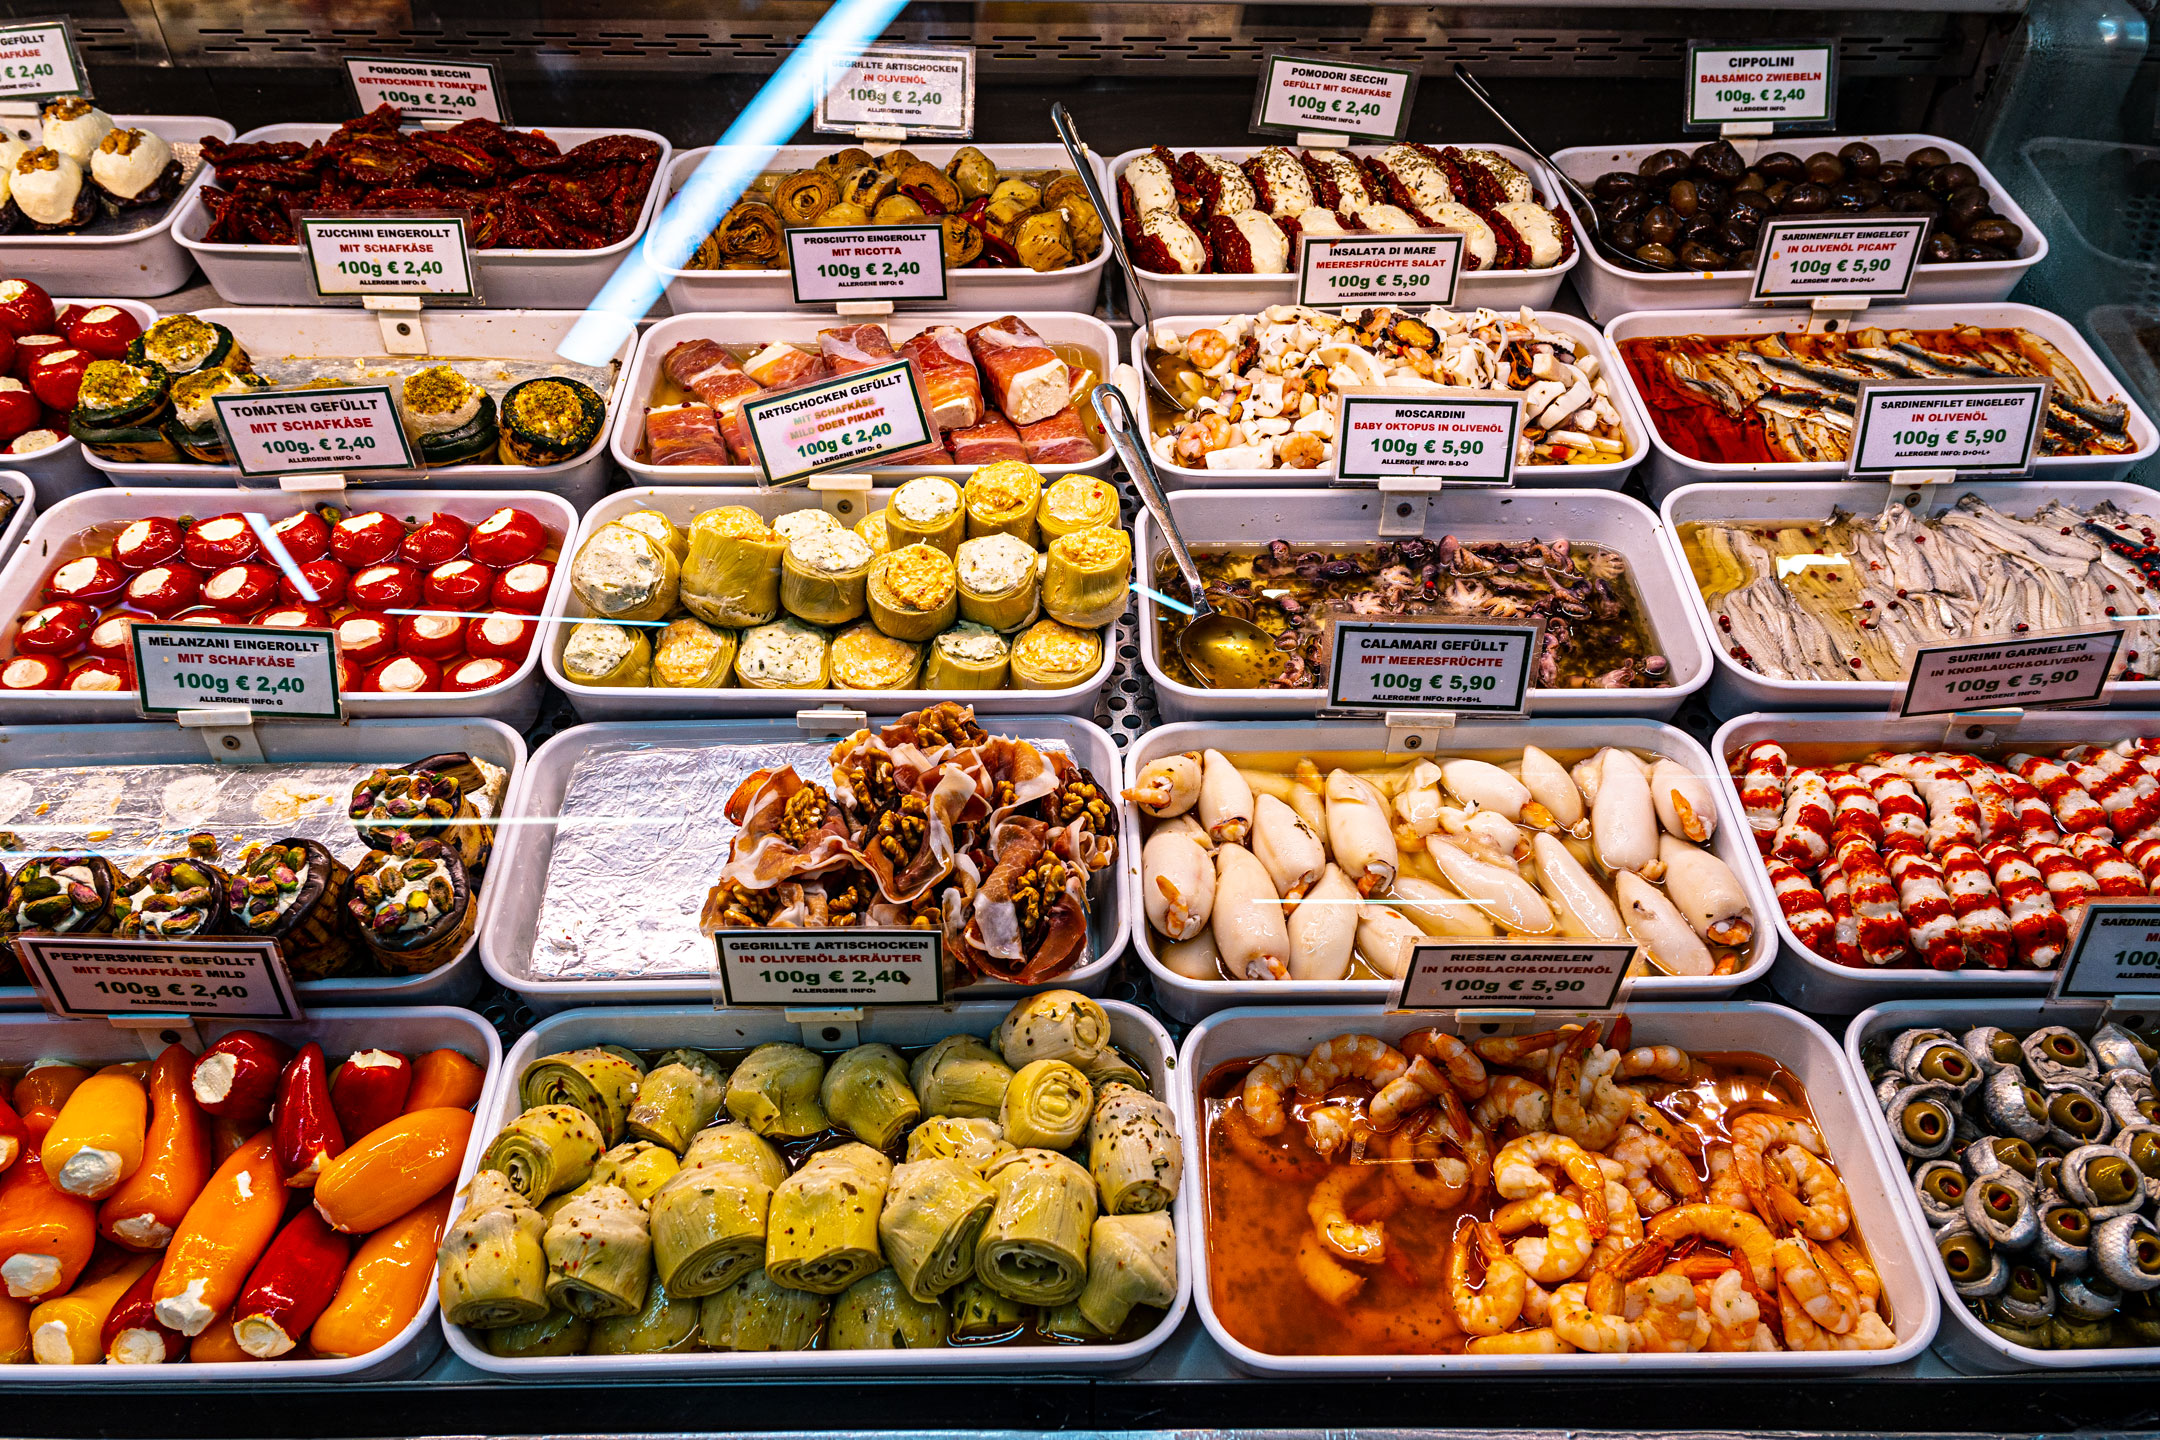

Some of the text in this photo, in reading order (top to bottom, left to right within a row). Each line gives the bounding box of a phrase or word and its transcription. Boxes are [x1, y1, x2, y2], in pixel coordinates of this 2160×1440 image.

[1, 35, 44, 45] GEFÜLLT
[886, 63, 958, 73] ARTISCHOCKEN
[1729, 57, 1794, 67] CIPPOLINI
[5, 64, 53, 79] € 2,40
[369, 66, 471, 79] POMODORI SECCHI
[1292, 68, 1387, 85] POMODORI SECCHI
[1701, 72, 1821, 83] BALSAMICO ZWIEBELN
[359, 77, 487, 91] GETROCKNETE TOMATEN
[877, 74, 926, 84] OLIVENÖL
[1283, 80, 1320, 90] GEFÜLLT
[1341, 87, 1391, 98] SCHAFKÄSE
[378, 91, 476, 107] 100g € 2,40
[848, 89, 942, 106] 100g € 2,40
[1716, 89, 1805, 104] 100g. € 2,40
[1288, 95, 1380, 116] 100g € 2,40
[317, 229, 373, 237] ZUCCHINI
[804, 234, 926, 244] PROSCIUTTO EINGEROLLT
[1782, 231, 1910, 241] SARDINENFILET EINGELEGT
[340, 243, 433, 252] MIT SCHAFKÄSE
[855, 247, 901, 255] RICOTTA
[1330, 248, 1385, 256] INSALATA
[1802, 243, 1853, 252] OLIVENÖL
[1857, 243, 1897, 251] PICANT
[338, 261, 443, 277] 100g € 2,40
[817, 262, 920, 279] 100g € 2,40
[1316, 259, 1408, 268] MEERESFRÜCHTE
[1790, 259, 1890, 275] 100g € 5,90
[1329, 275, 1430, 289] 100g € 5,90
[759, 375, 902, 420] ARTISCHOCKEN GEFÜLLT
[1881, 399, 2024, 409] SARDINENFILET EINGELEGT
[231, 399, 377, 417] TOMATEN GEFÜLLT
[794, 397, 875, 425] MIT SCHAFKÄSE
[1395, 410, 1465, 418] MOSCARDINI
[1912, 411, 1987, 422] IN OLIVENÖL
[250, 417, 373, 434] MIT SCHAFKÄSE
[790, 408, 885, 440] MILD ODER PIKANT
[1386, 423, 1434, 431] OKTOPUS
[1452, 424, 1503, 432] OLIVENÖL
[262, 436, 375, 455] 100g. € 2,40
[797, 423, 891, 457] 100g € 2,40
[1893, 429, 2006, 448] 100g € 5,90
[1371, 439, 1483, 457] 100g € 5,90
[149, 637, 319, 652] MELANZANI EINGEROLLT
[1361, 639, 1508, 651] CALAMARI GEFÜLLT
[1948, 643, 2087, 664] SURIMI GARNELEN
[178, 654, 295, 668] MIT SCHAFKÄSE
[1361, 655, 1503, 667] MIT MEERESFRÜCHTE
[1947, 654, 2096, 676] KNOBLAUCH&OLIVENÖL
[174, 673, 304, 694] 100g € 2,40
[1370, 673, 1495, 693] 100g € 5,90
[1945, 669, 2079, 693] 100g € 5,90
[730, 941, 928, 950] GEGRILLTE ARTISCHOCKEN
[50, 952, 256, 966] PEPPERSWEET GEFÜLLT
[739, 953, 922, 963] IN OLIVENÖL&KRÄUTER
[72, 966, 245, 979] MIT SCHAFKÄSE MILD
[1443, 965, 1612, 974] KNOBLACH&OLIVENÖL
[760, 970, 820, 985] 100g
[829, 971, 844, 982] €
[95, 981, 248, 1000] 100g € 2,40
[1441, 979, 1584, 993] 100g € 5,90
